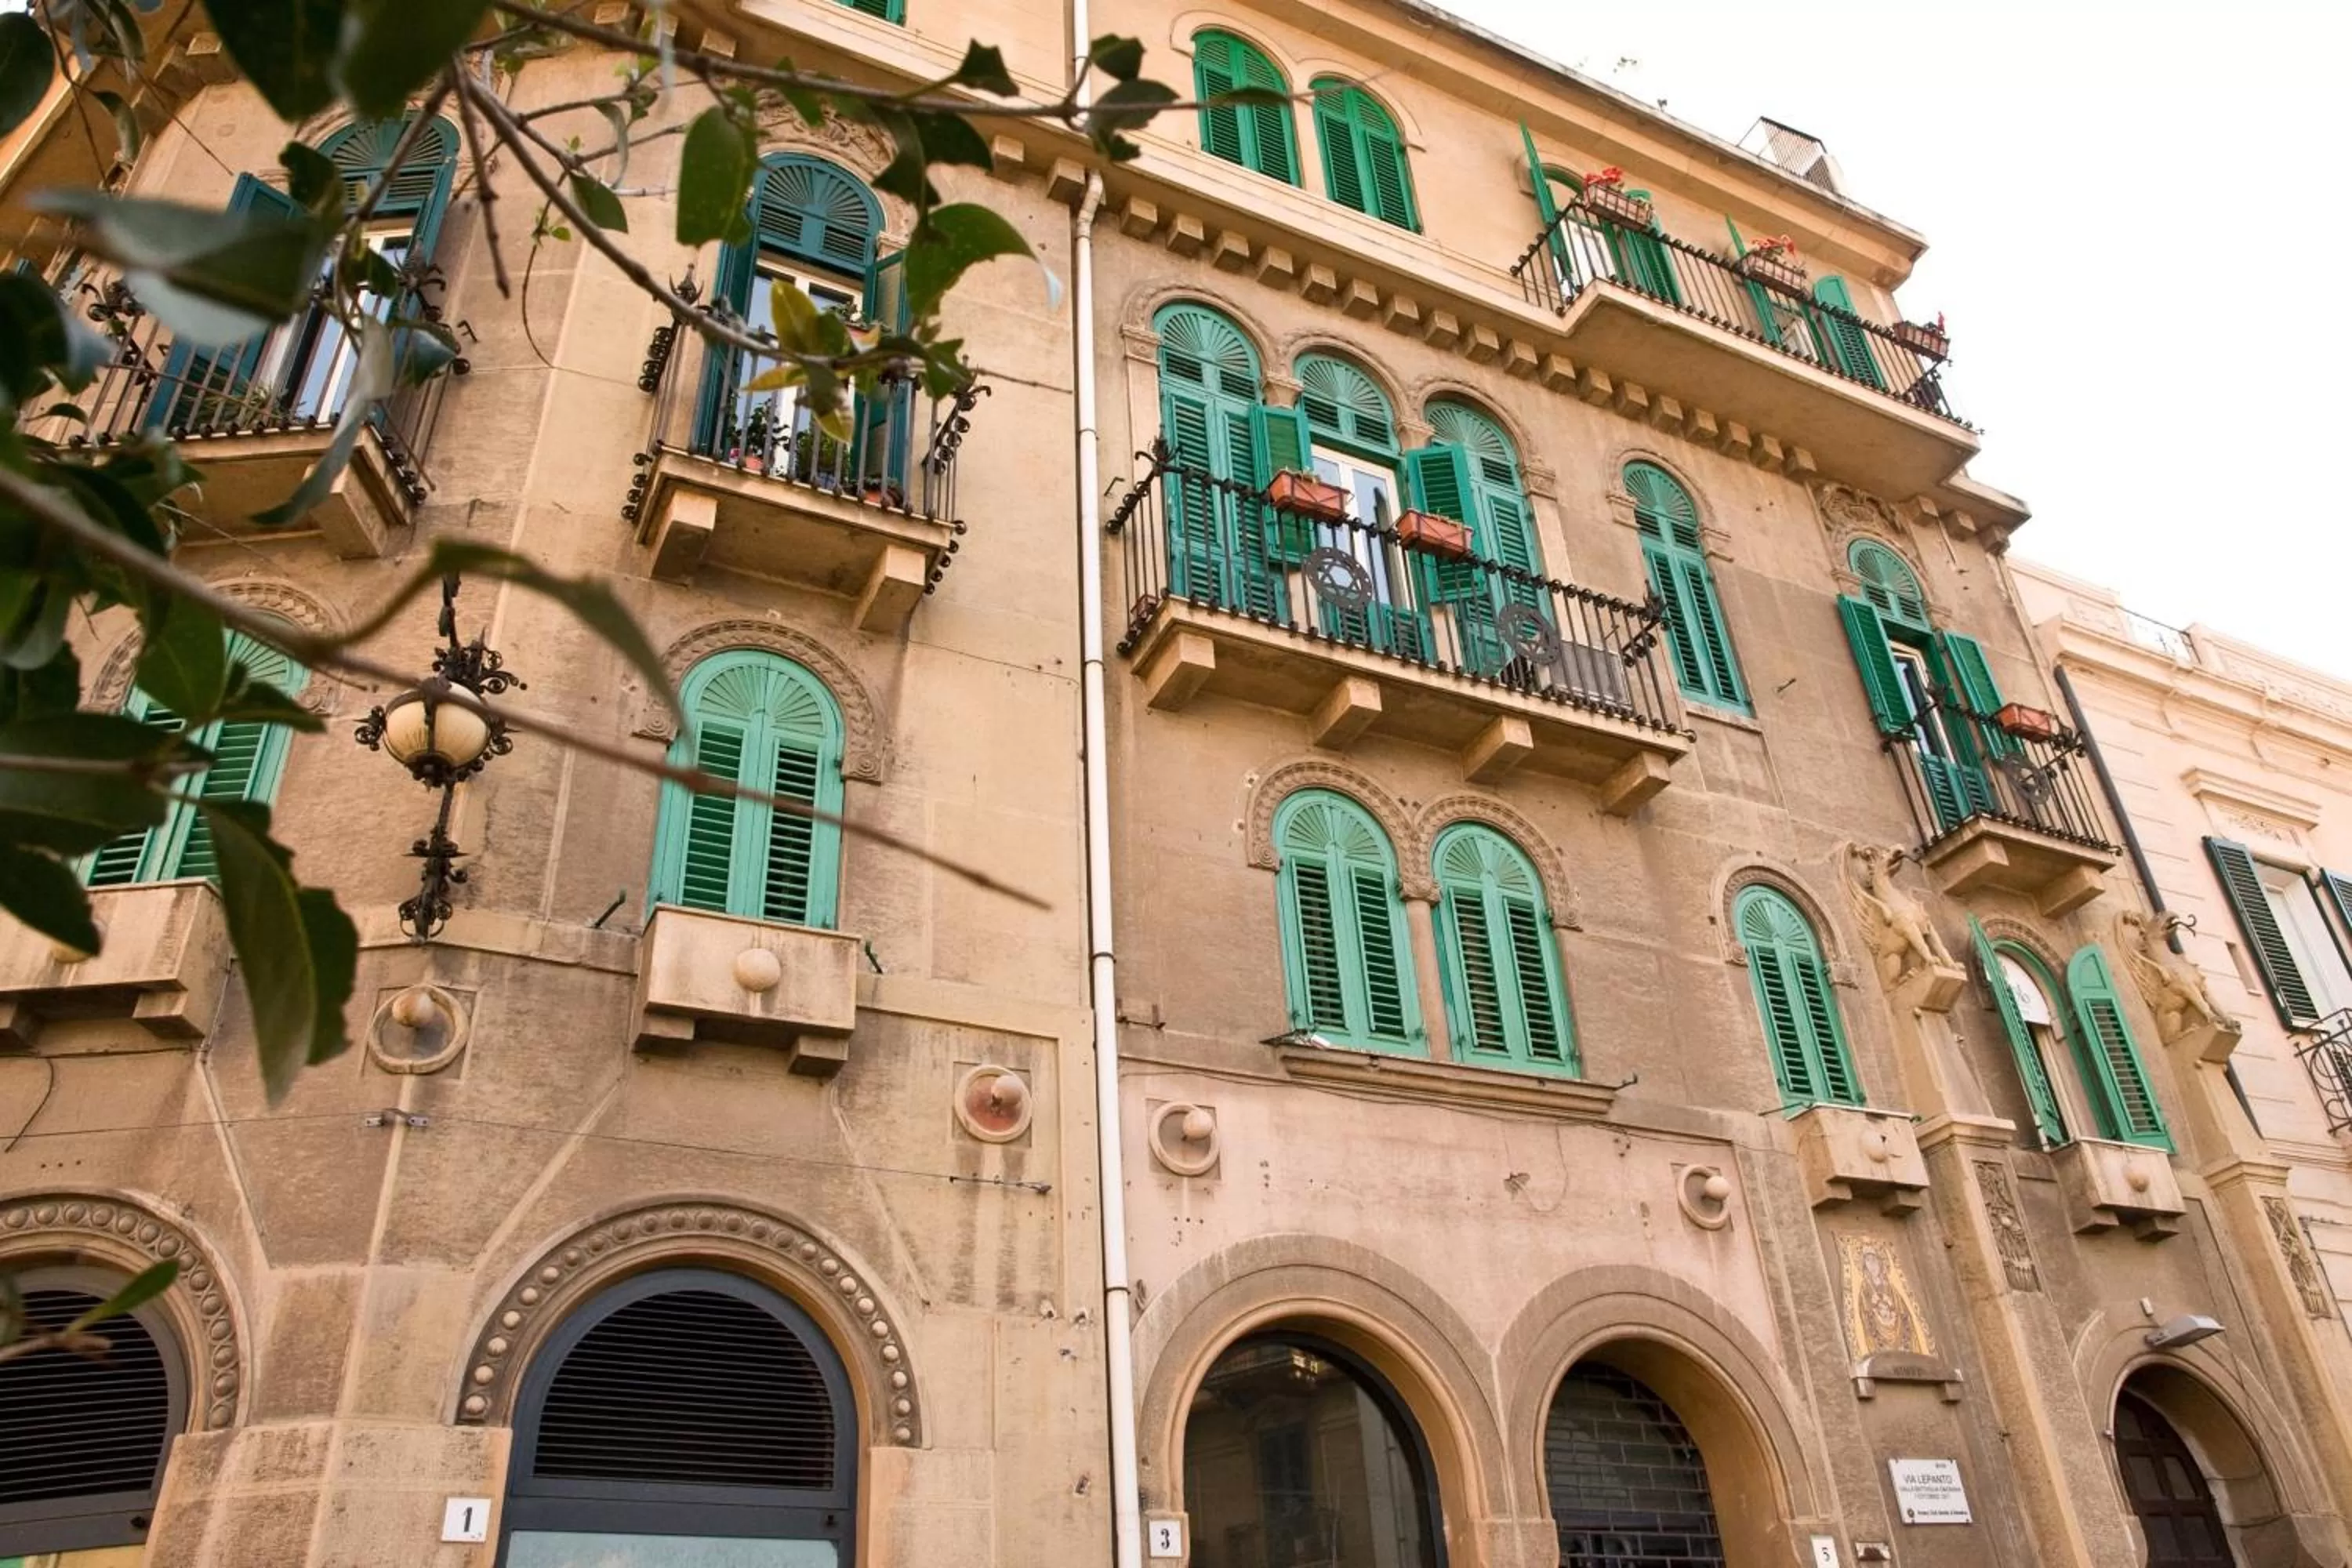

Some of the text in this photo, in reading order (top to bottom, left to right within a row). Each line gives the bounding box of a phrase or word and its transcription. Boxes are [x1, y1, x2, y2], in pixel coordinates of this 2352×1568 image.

[1904, 1474, 1953, 1484] VIA LEPANTO
[462, 1507, 473, 1533] 1
[1160, 1528, 1170, 1550] 3
[1821, 1547, 1831, 1563] 5
